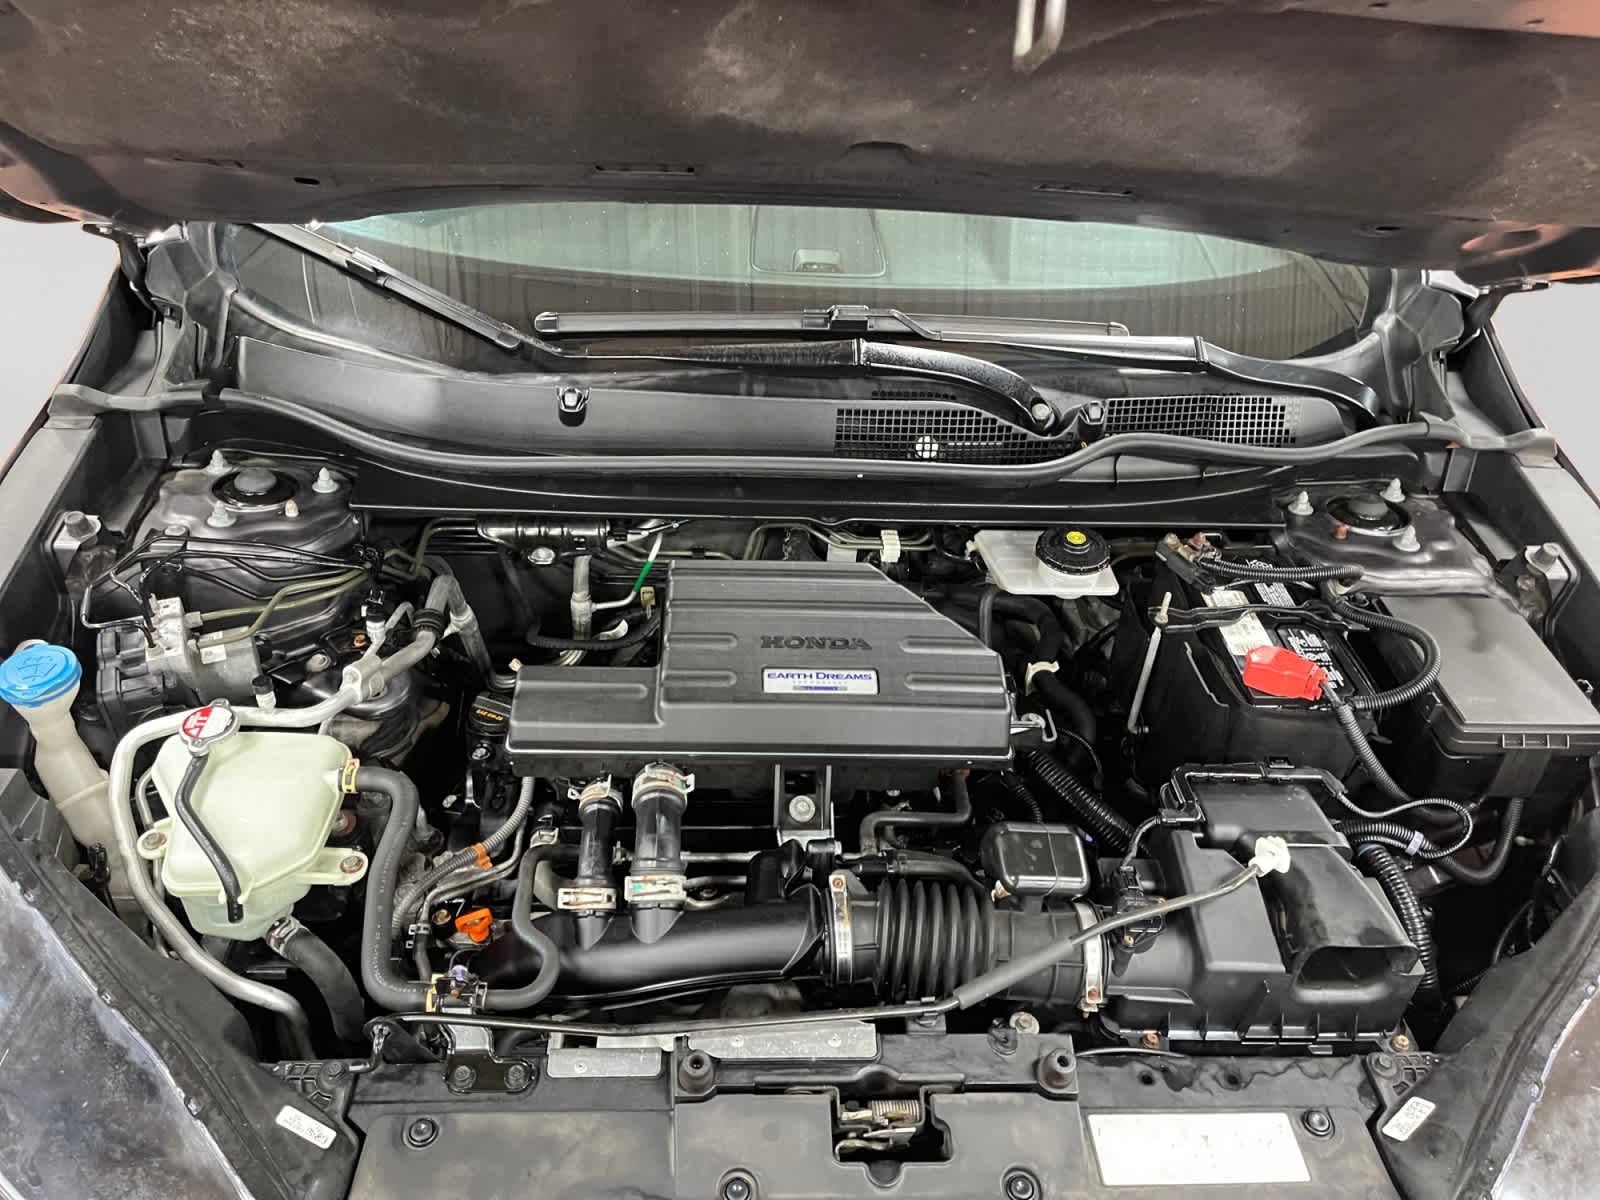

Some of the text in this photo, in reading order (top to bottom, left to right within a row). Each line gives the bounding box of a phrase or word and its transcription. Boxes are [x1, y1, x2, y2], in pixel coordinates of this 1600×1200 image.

[760, 635, 872, 650] HONDA
[767, 671, 873, 681] EARTH DREAMS
